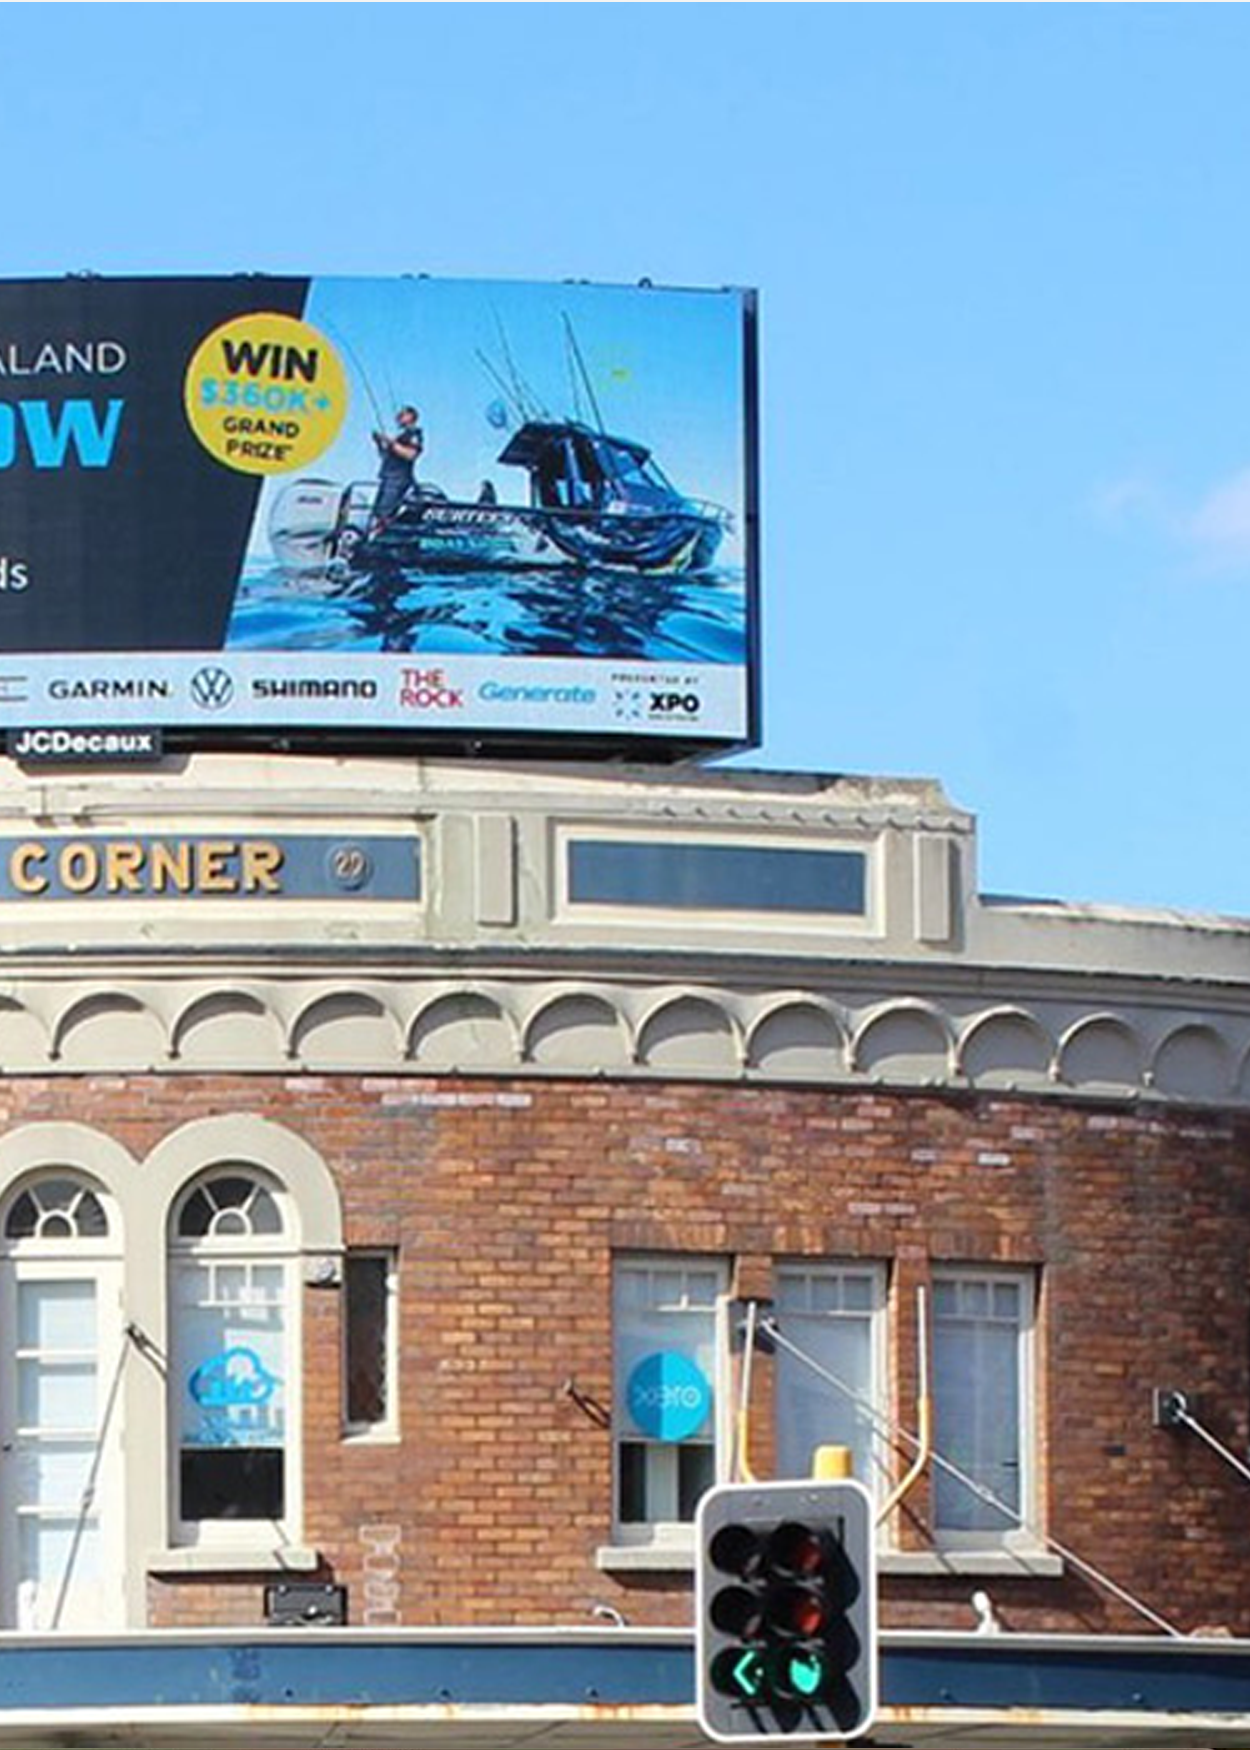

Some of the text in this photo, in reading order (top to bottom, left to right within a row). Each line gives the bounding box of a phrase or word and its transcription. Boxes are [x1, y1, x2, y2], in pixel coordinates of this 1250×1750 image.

[222, 339, 318, 383] WIN
[223, 416, 301, 439] GRAND
[253, 679, 377, 699] SHIMANO
[401, 668, 445, 688] THE
[48, 680, 168, 699] GARMIN
[400, 688, 463, 708] ROCK
[478, 681, 597, 704] Generate
[649, 691, 701, 713] XPO
[14, 731, 152, 755] JCDecaux
[9, 839, 284, 894] CORNER
